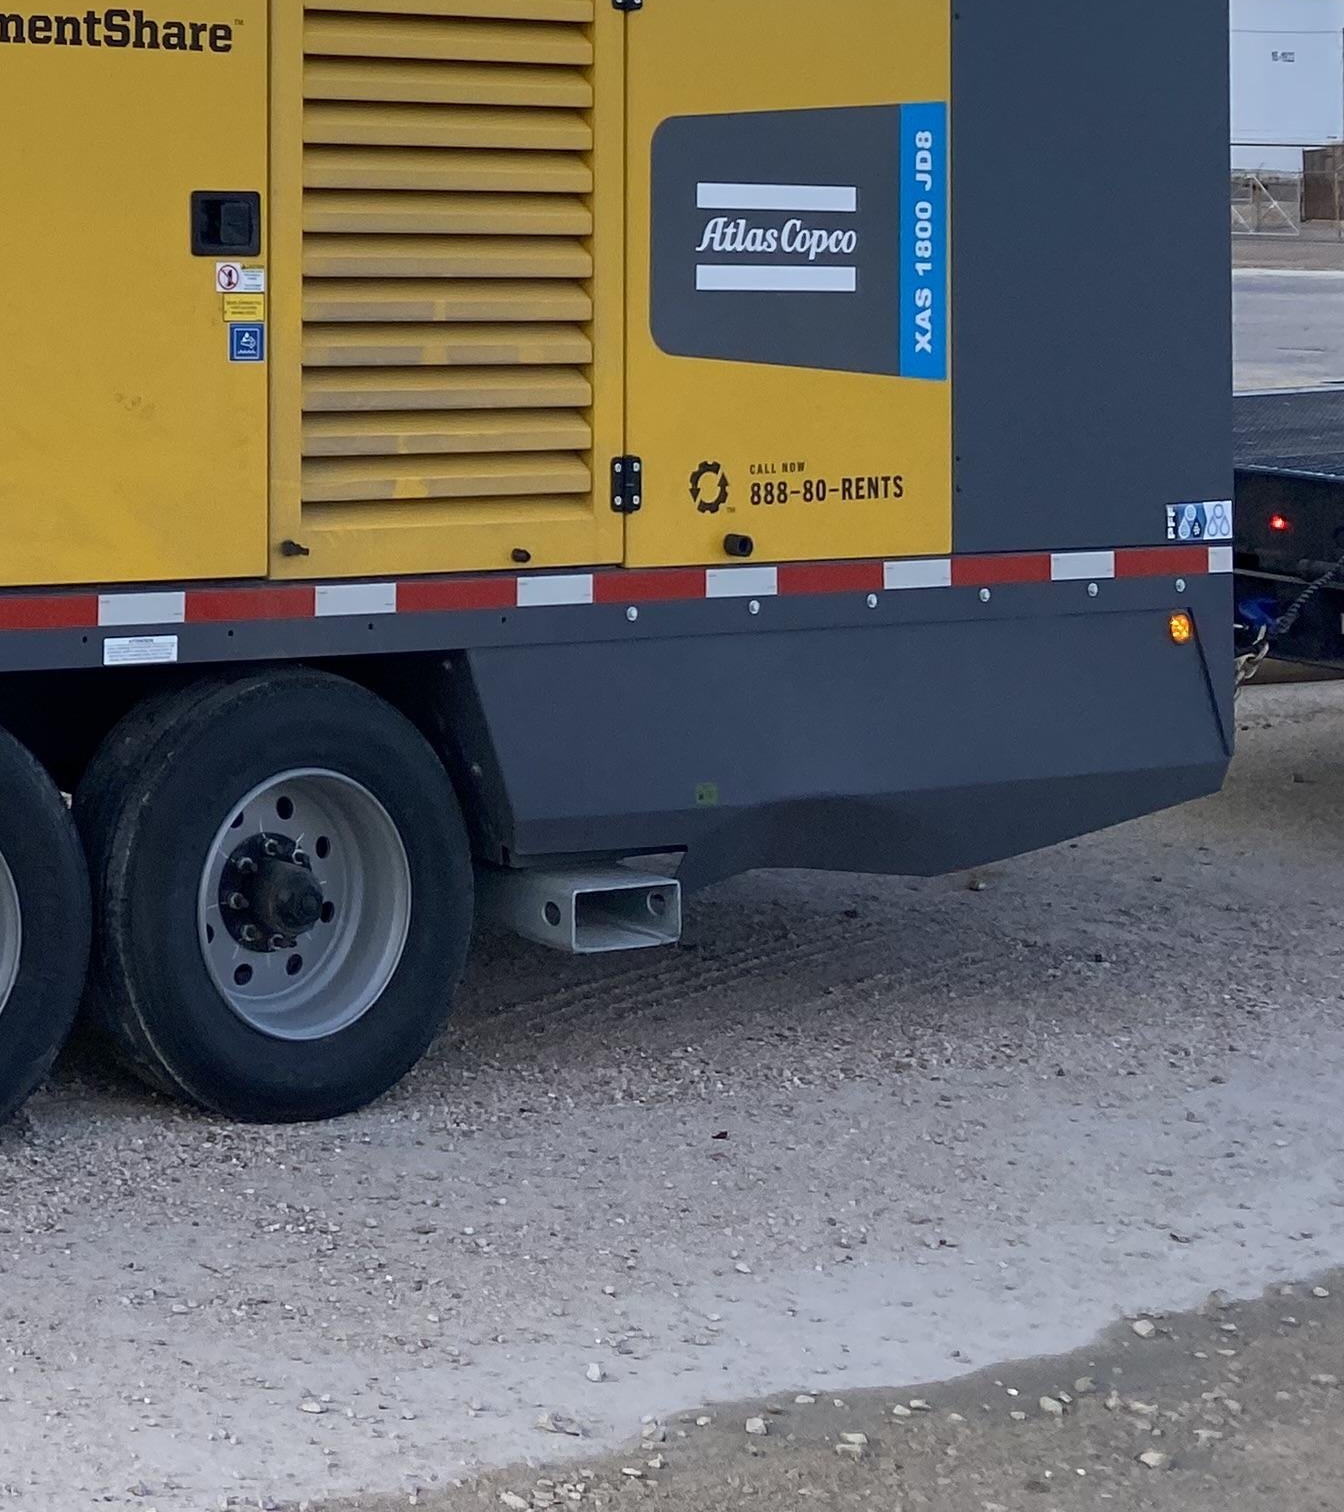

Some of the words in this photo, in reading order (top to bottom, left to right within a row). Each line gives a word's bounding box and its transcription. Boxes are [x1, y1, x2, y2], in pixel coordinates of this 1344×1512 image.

[915, 130, 933, 192] JD8
[696, 216, 778, 253] Atlas
[780, 218, 858, 261] Copco
[915, 200, 933, 277] 1800
[915, 287, 933, 354] XAS
[749, 463, 777, 476] CALL
[781, 461, 806, 474] NOW
[749, 474, 905, 507] 888-80-RENTS
